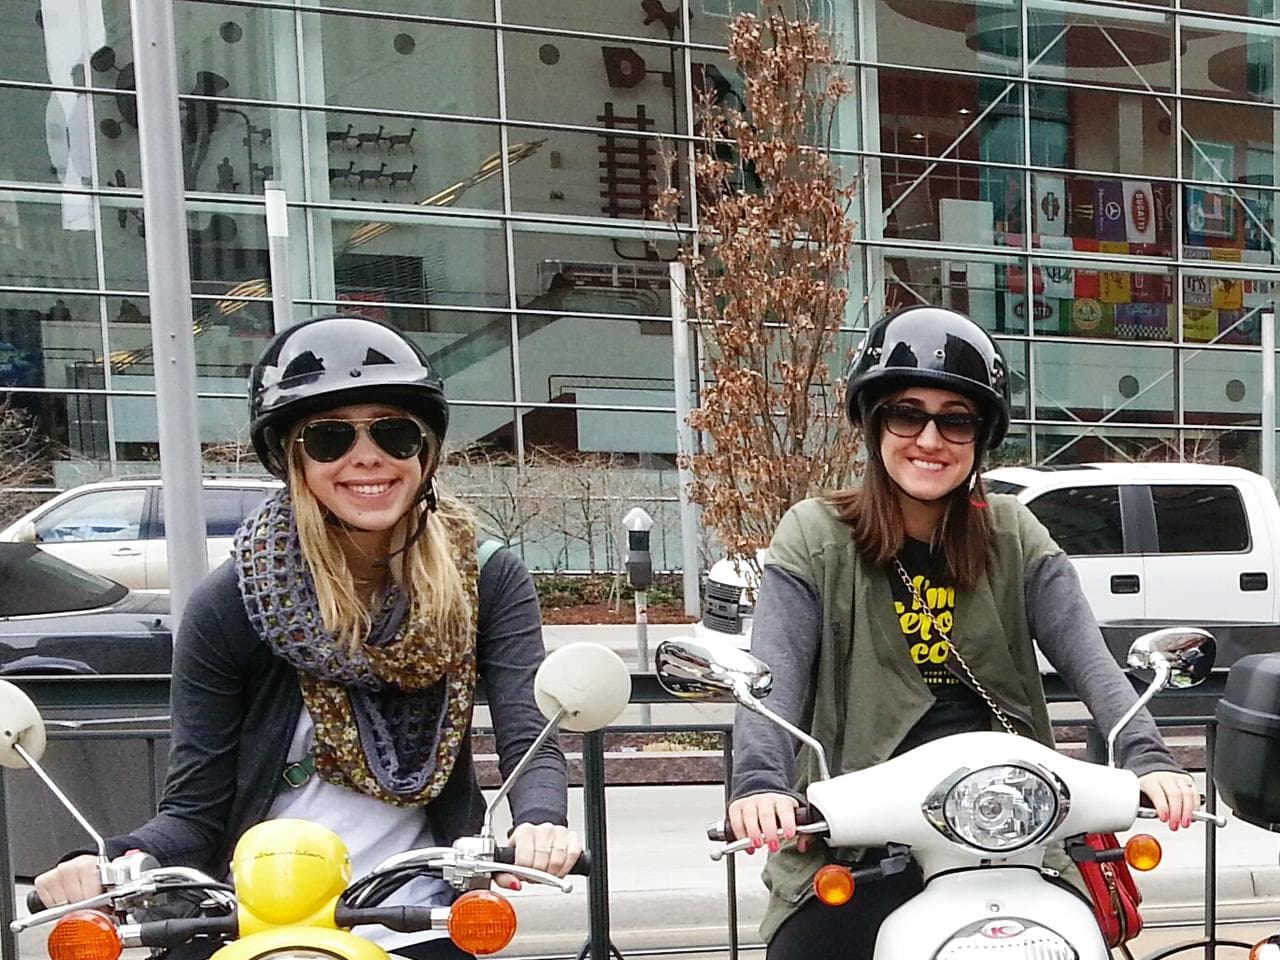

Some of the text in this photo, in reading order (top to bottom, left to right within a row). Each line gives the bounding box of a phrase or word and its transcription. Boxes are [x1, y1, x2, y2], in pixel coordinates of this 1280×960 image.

[1135, 193, 1145, 231] BUGATTI
[1016, 306, 1050, 317] BATTI
[899, 609, 954, 641] ero
